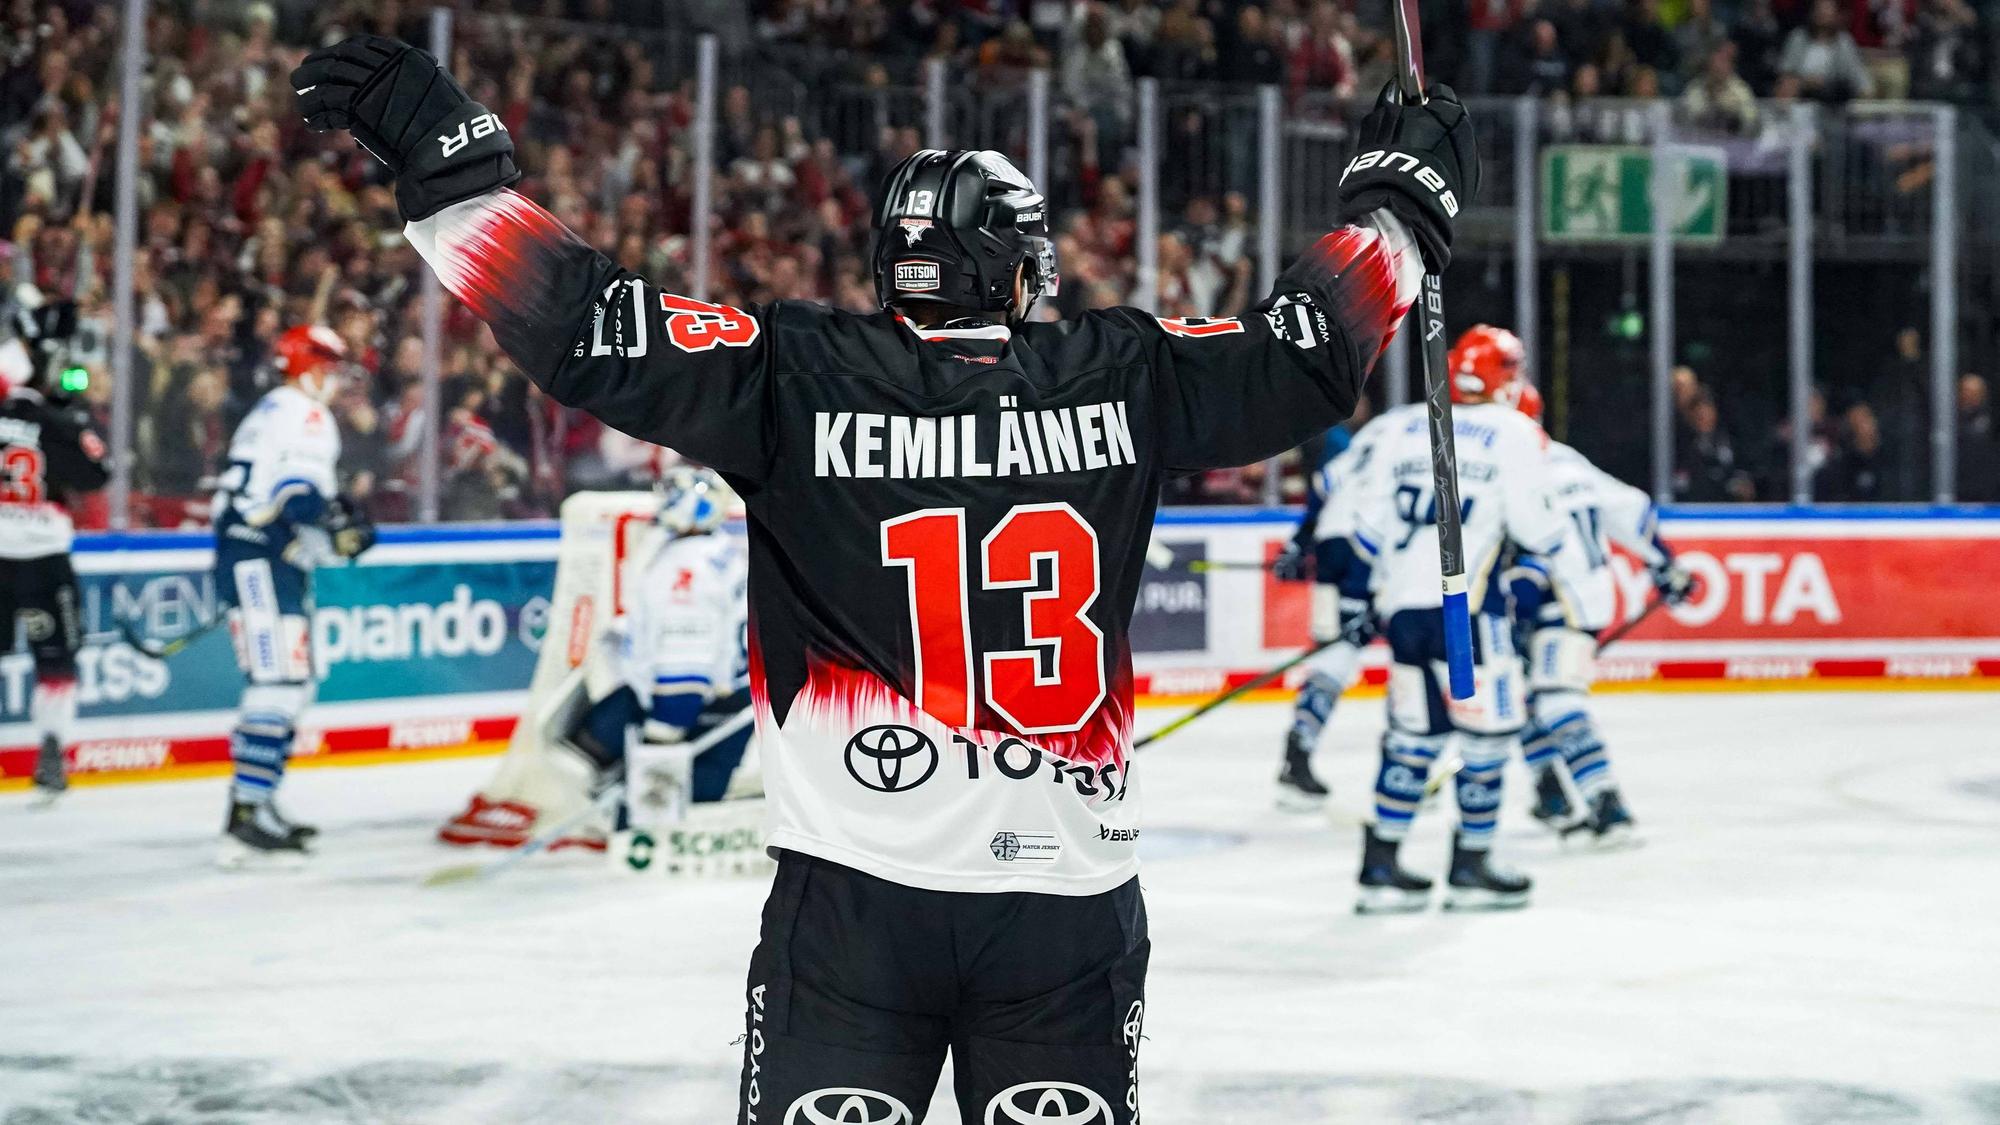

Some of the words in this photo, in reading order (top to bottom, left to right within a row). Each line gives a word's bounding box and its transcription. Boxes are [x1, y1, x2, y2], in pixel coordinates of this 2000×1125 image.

[906, 190, 933, 215] 13
[1017, 212, 1042, 222] BAUER
[897, 265, 937, 279] STETSON
[659, 292, 761, 353] 13
[814, 395, 1137, 479] KEMILÄINEN
[880, 501, 1107, 735] 13
[1608, 550, 1843, 628] YOTA
[746, 983, 767, 1125] TOYOTA
